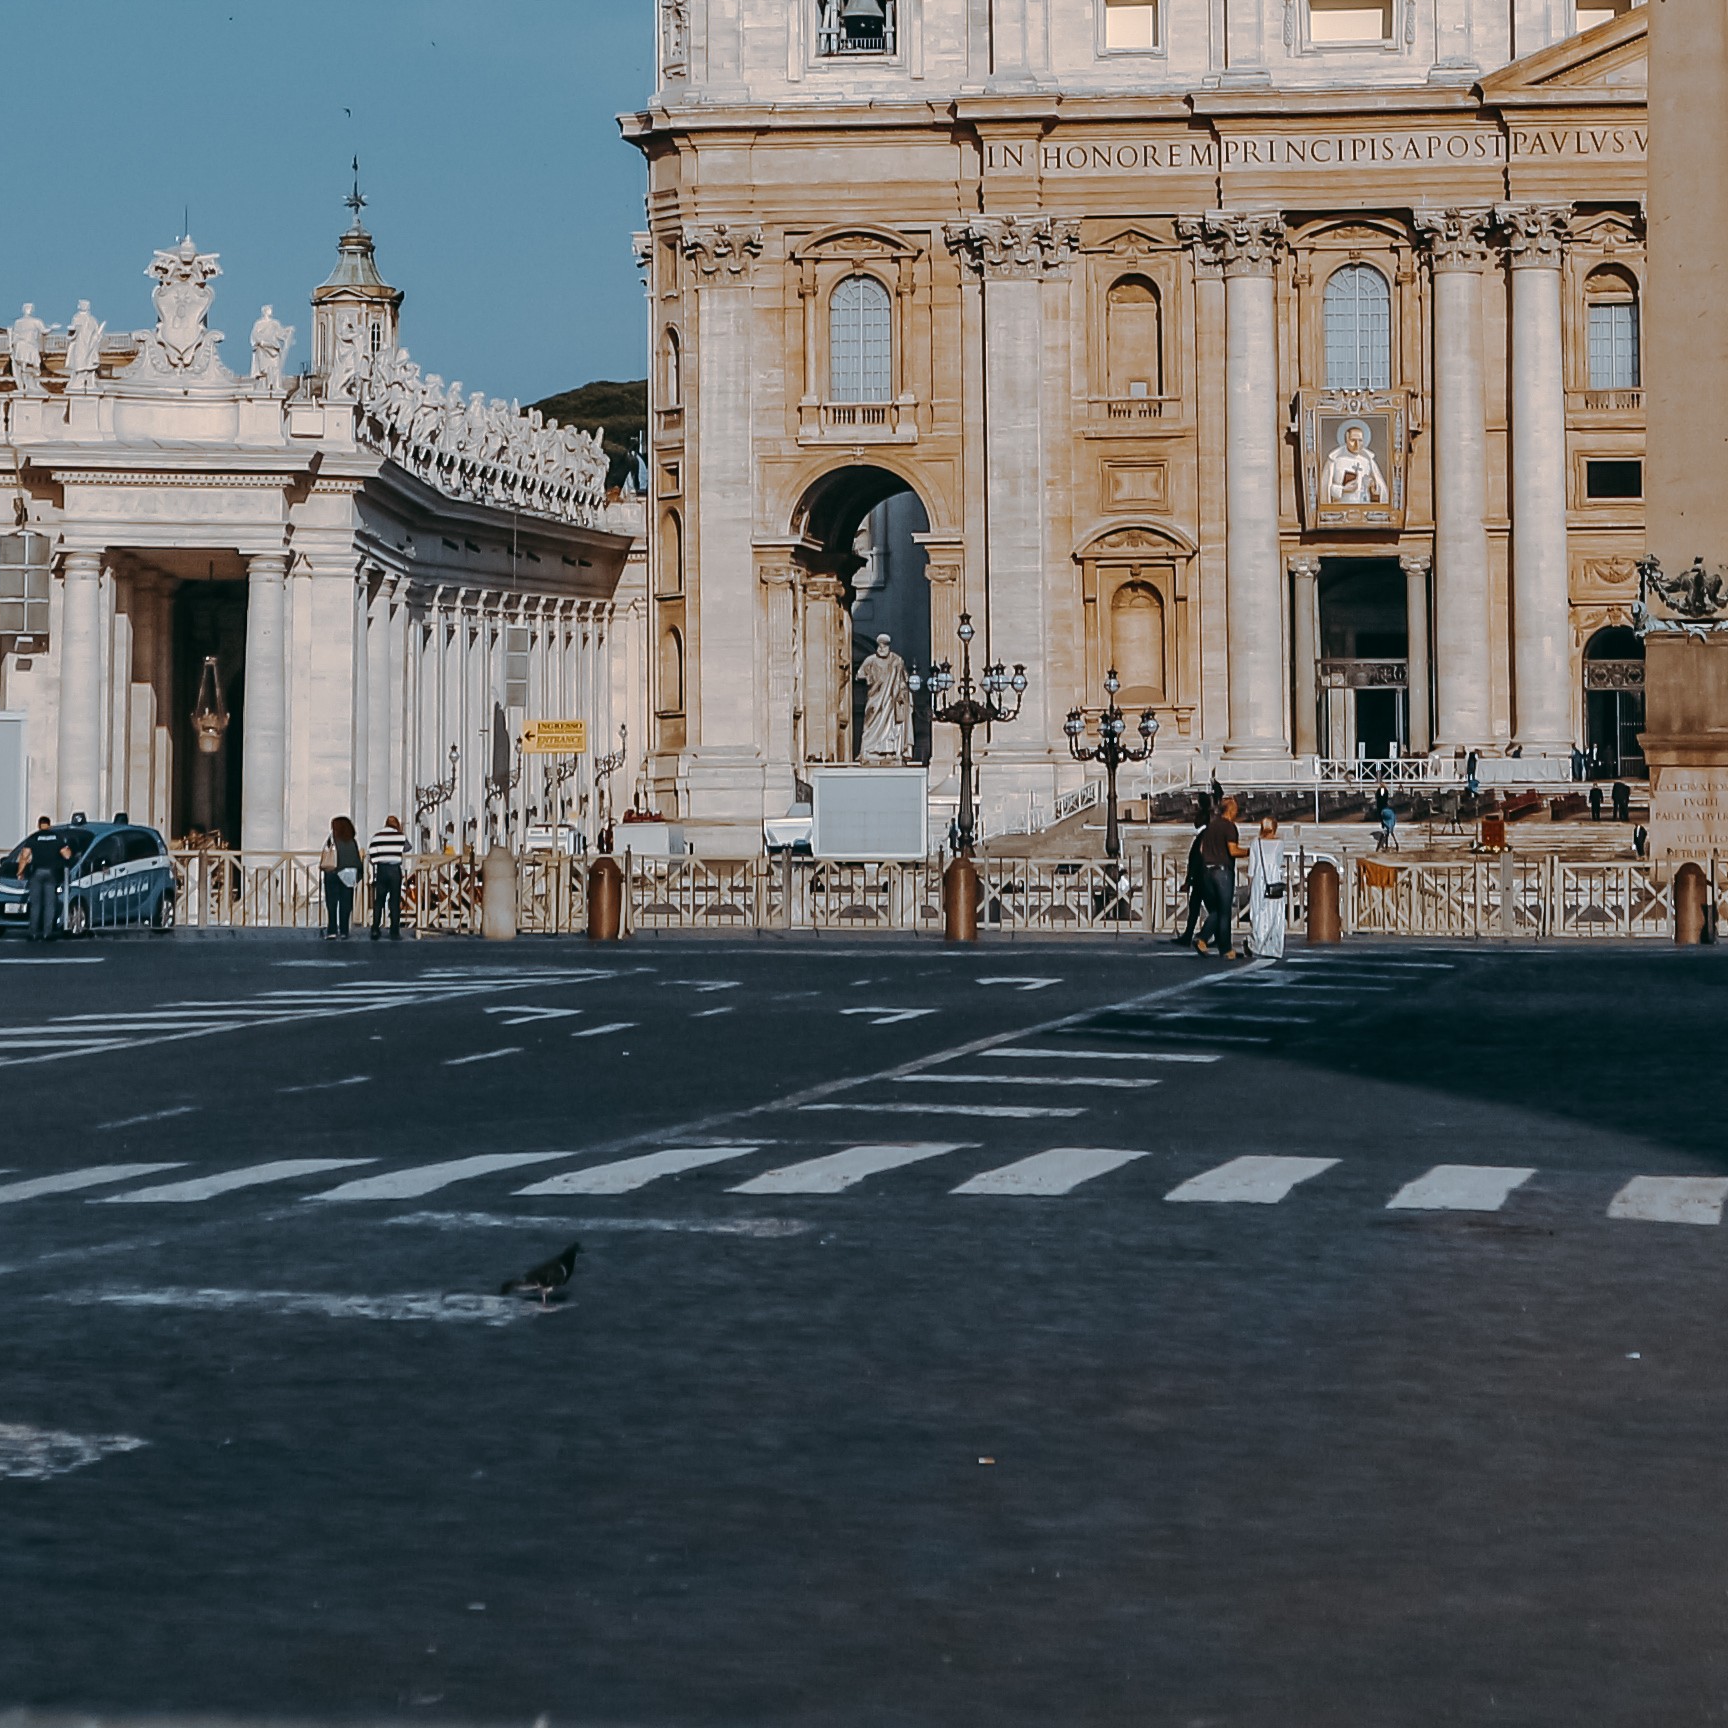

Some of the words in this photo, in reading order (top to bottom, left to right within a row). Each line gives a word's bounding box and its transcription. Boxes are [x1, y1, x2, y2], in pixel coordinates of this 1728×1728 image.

[987, 144, 1023, 169] IN
[1042, 143, 1214, 170] HONOREM
[1223, 136, 1394, 164] PRINCIPIS
[1401, 134, 1504, 161] APOST
[1511, 130, 1626, 156] PAVLVS
